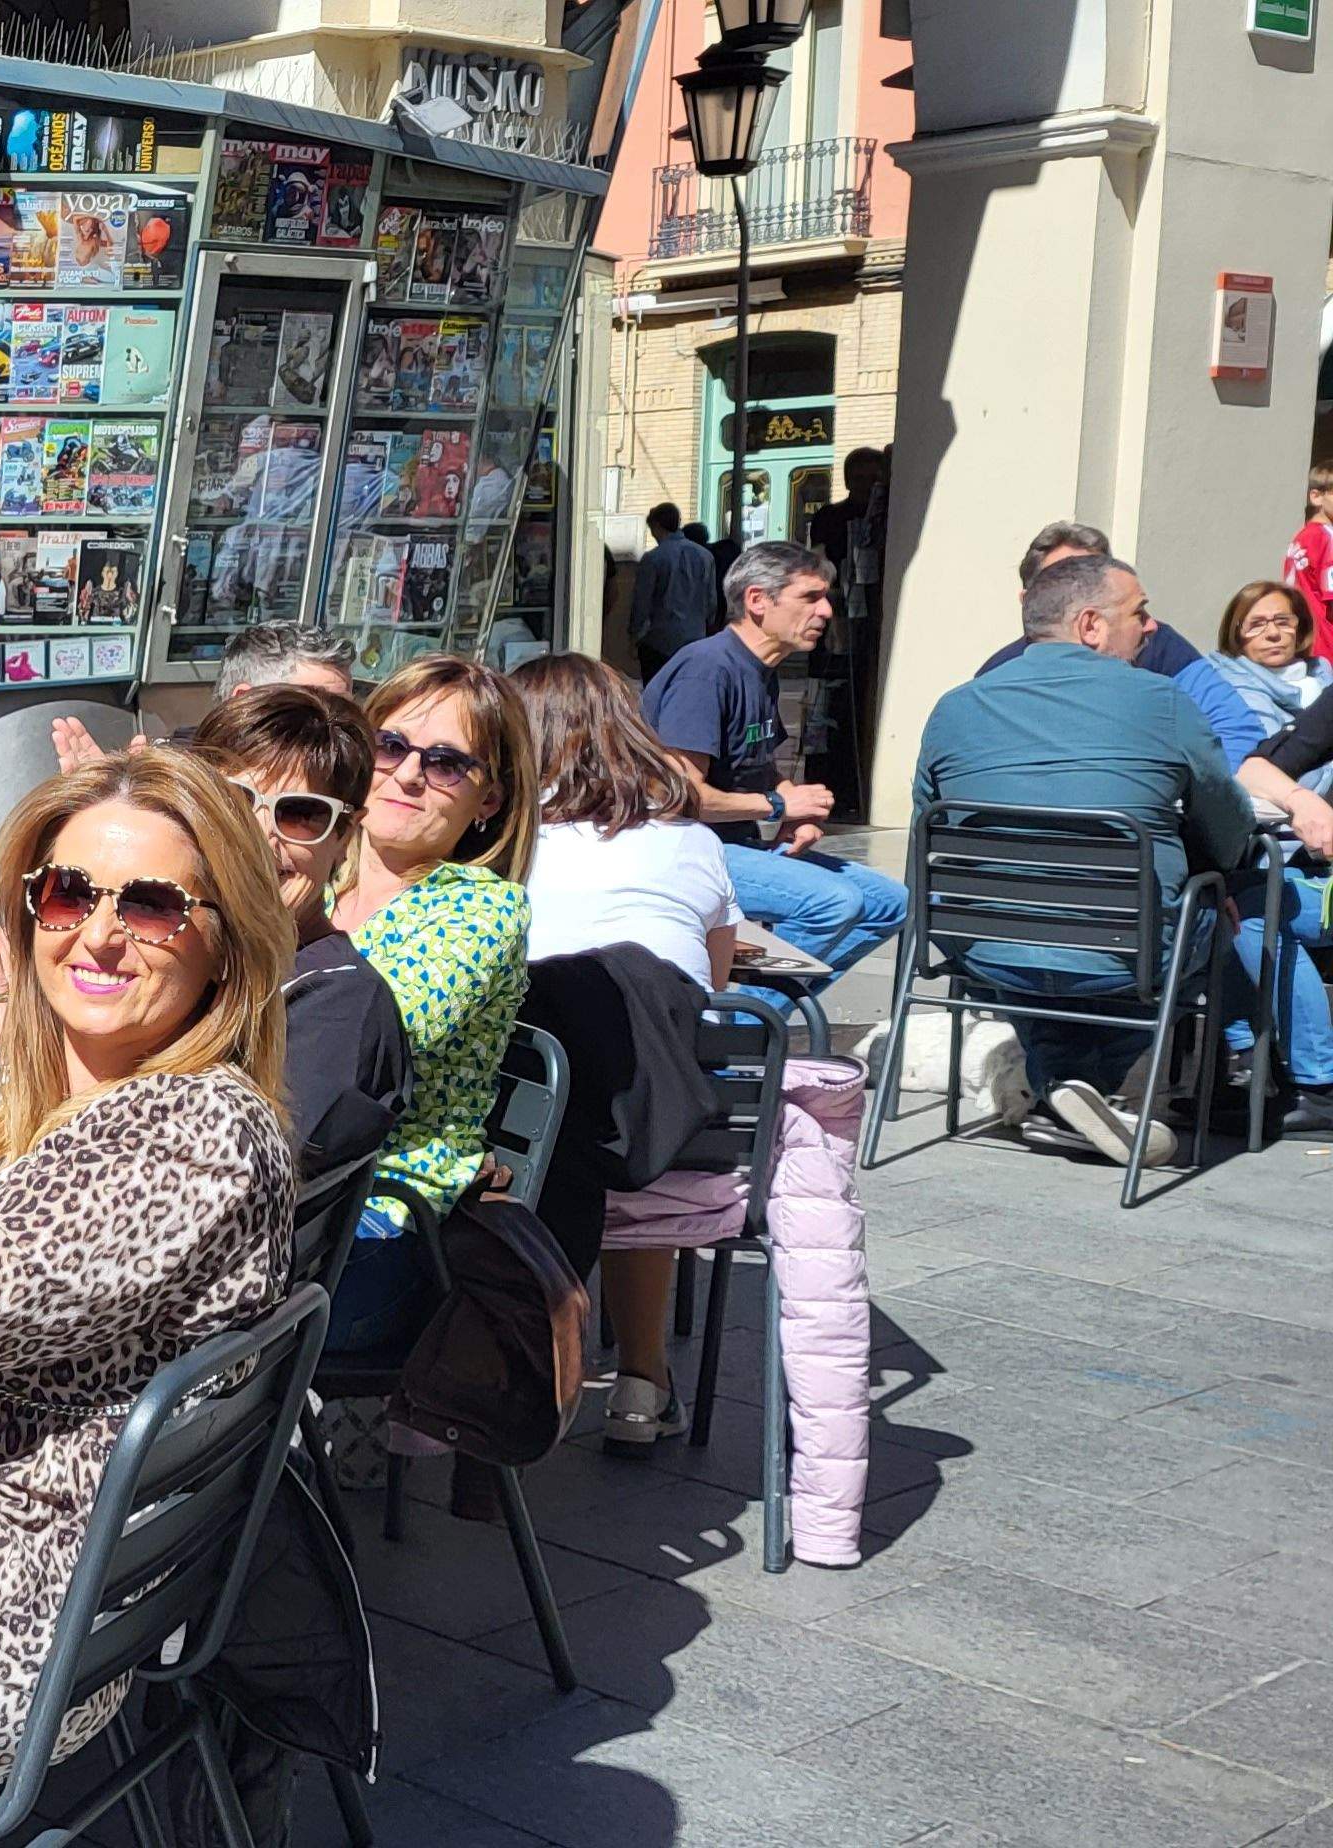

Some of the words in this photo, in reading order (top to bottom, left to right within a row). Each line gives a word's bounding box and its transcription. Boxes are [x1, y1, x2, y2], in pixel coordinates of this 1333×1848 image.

[48, 112, 65, 171] OCÉANOS
[71, 112, 87, 171] muy
[140, 116, 156, 172] UNIVERSO
[276, 144, 331, 165] muy
[64, 193, 125, 221] yoga
[462, 214, 504, 233] trofeo
